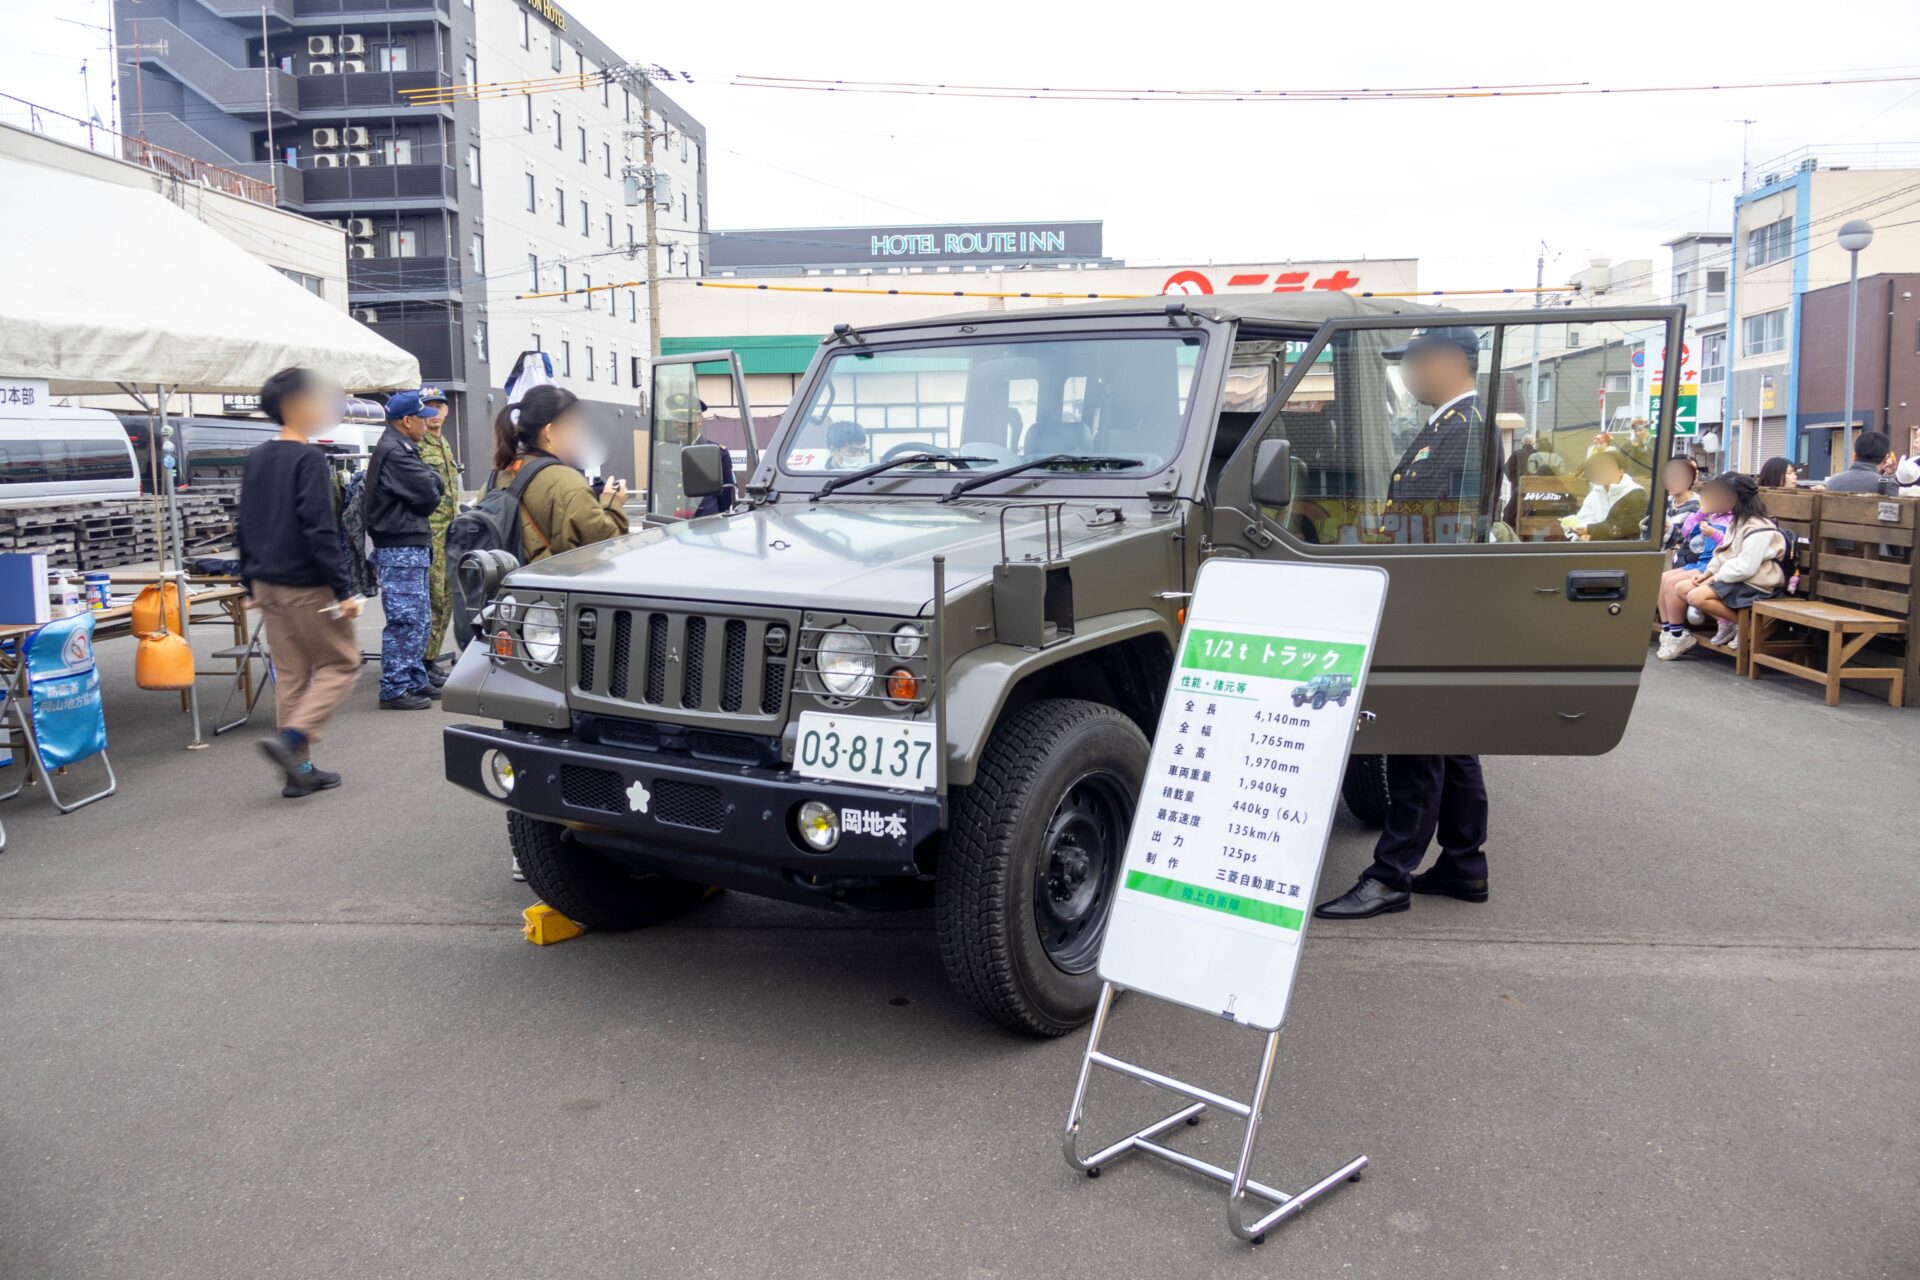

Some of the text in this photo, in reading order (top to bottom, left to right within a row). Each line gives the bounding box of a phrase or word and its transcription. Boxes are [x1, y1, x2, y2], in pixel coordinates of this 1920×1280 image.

[528, 0, 567, 32] ON HOTEL
[871, 231, 1065, 255] HOTEL ROUTE INN
[1262, 643, 1340, 670] トラック
[1181, 675, 1248, 694] 性能・諸元等
[1254, 710, 1311, 728] 4,140mm
[1250, 733, 1305, 751] 1,765mm
[802, 730, 932, 780] 03-8137
[1244, 755, 1300, 774] 1,970mm
[1168, 765, 1288, 798] 車両重量 1,940kg
[1162, 786, 1195, 803] 積載量
[841, 808, 907, 839] 岡地本
[1157, 808, 1281, 843] 最高速度 135km/h
[1222, 846, 1257, 864] 125ps
[1216, 868, 1301, 898] 三菱自動車工業
[1182, 886, 1241, 911] 陸上自衛隊
